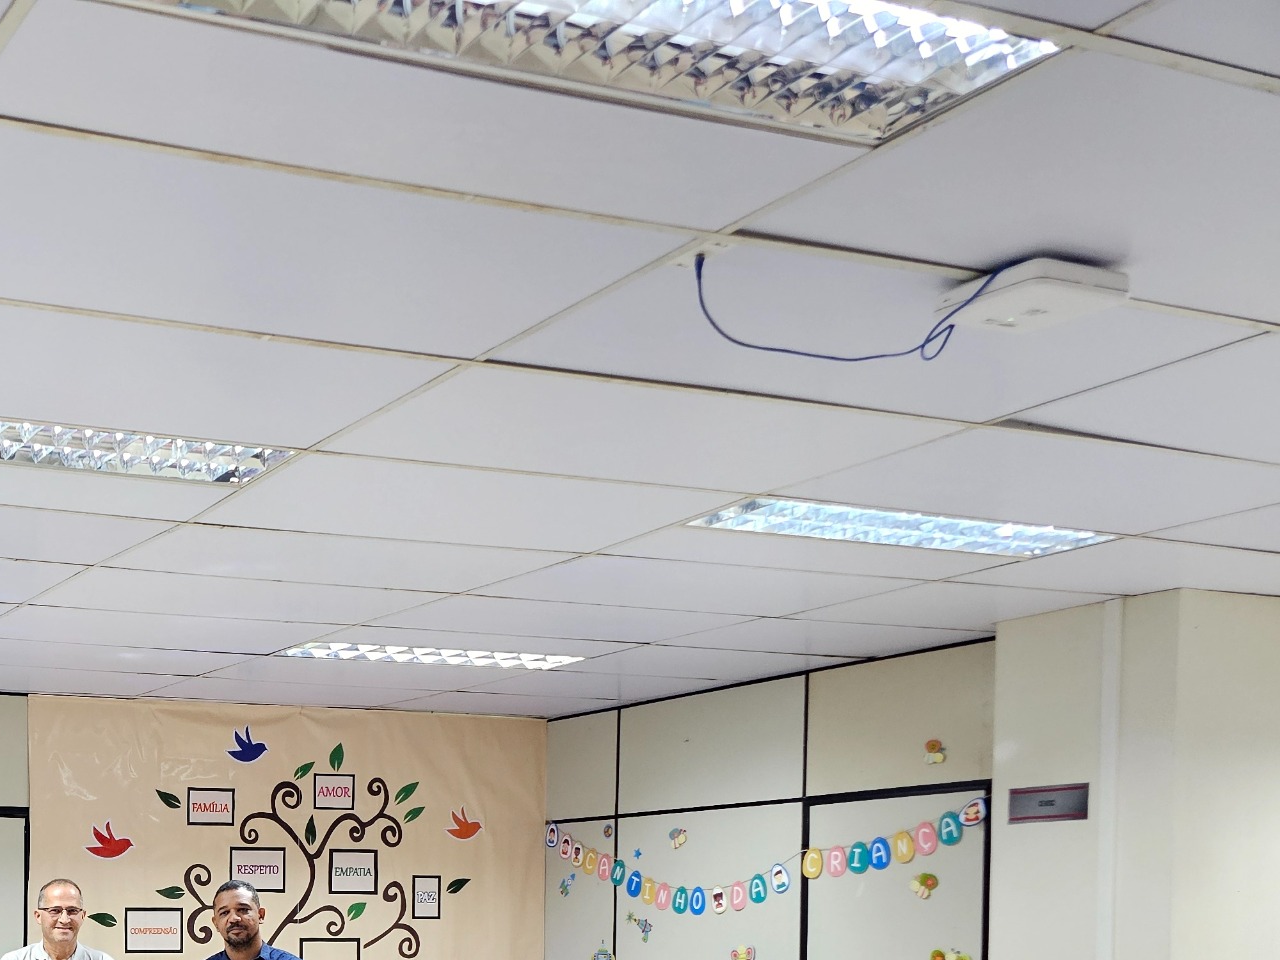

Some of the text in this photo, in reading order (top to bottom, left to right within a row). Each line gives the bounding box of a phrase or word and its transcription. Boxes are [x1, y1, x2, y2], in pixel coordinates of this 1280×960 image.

[317, 786, 351, 798] AMOR
[191, 802, 230, 813] FAMÍLIA
[585, 816, 960, 910] CANTINHO DA CRIANÇA
[236, 864, 280, 875] RESPEITO
[334, 867, 373, 877] EMPATIA
[416, 891, 437, 904] PAZ
[130, 926, 178, 935] COMPREENSÃO
